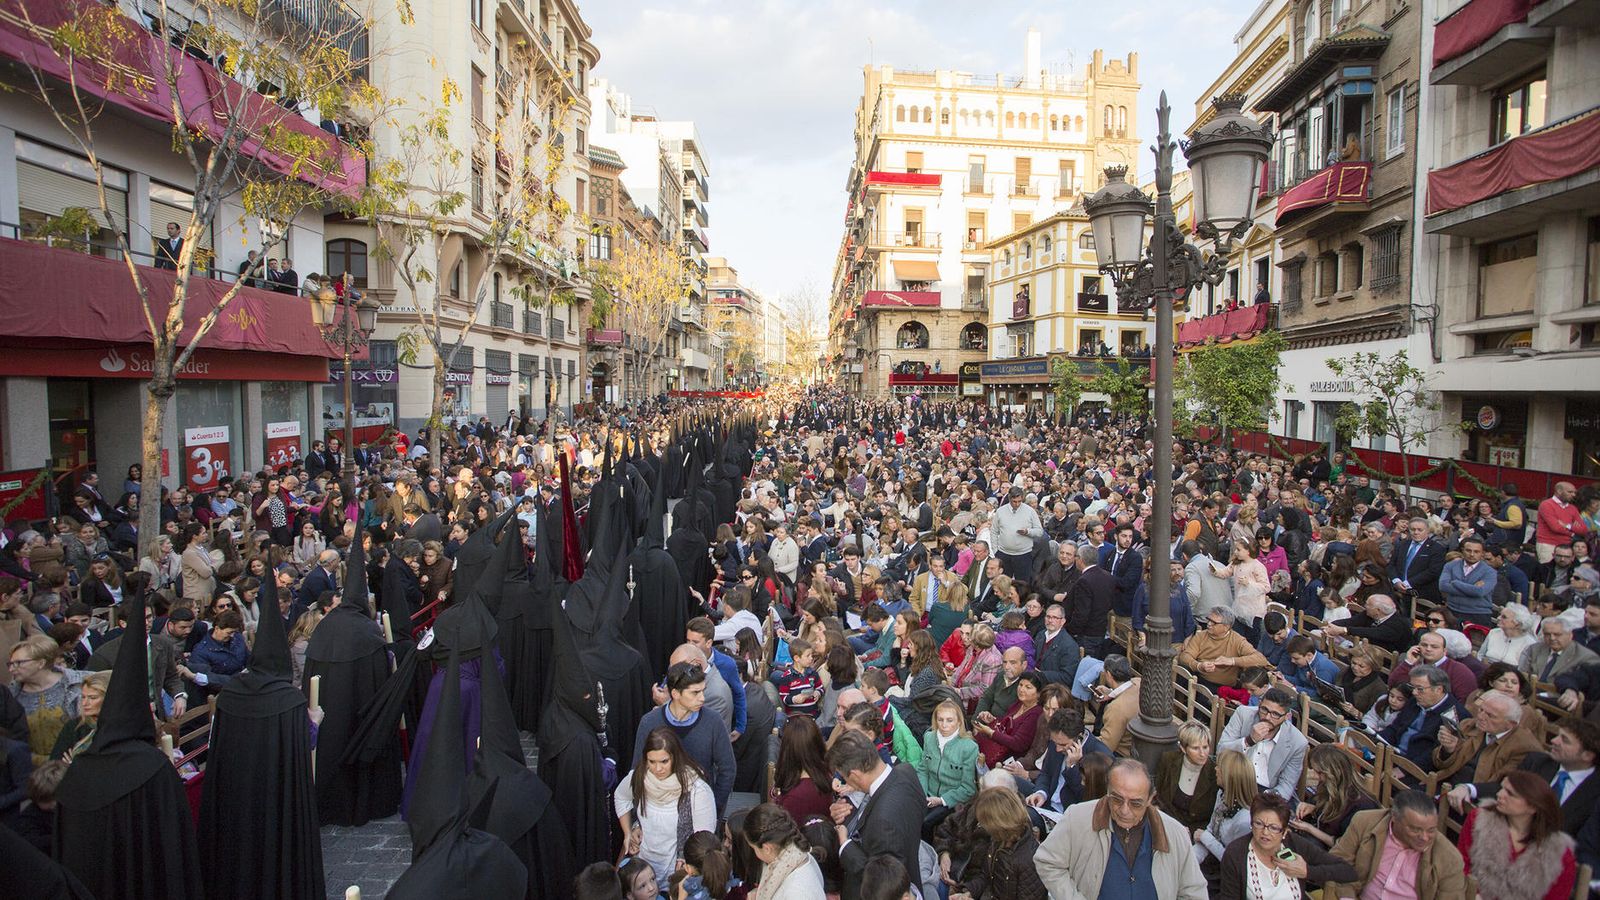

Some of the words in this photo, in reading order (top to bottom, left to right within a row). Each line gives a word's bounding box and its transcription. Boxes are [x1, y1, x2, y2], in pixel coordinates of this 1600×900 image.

[396, 305, 427, 313] FRANO
[130, 352, 210, 374] Sader
[445, 372, 471, 382] DENTIX
[1310, 380, 1355, 393] CALZEDONIA
[196, 432, 213, 440] Cuenta
[191, 447, 229, 485] 3%
